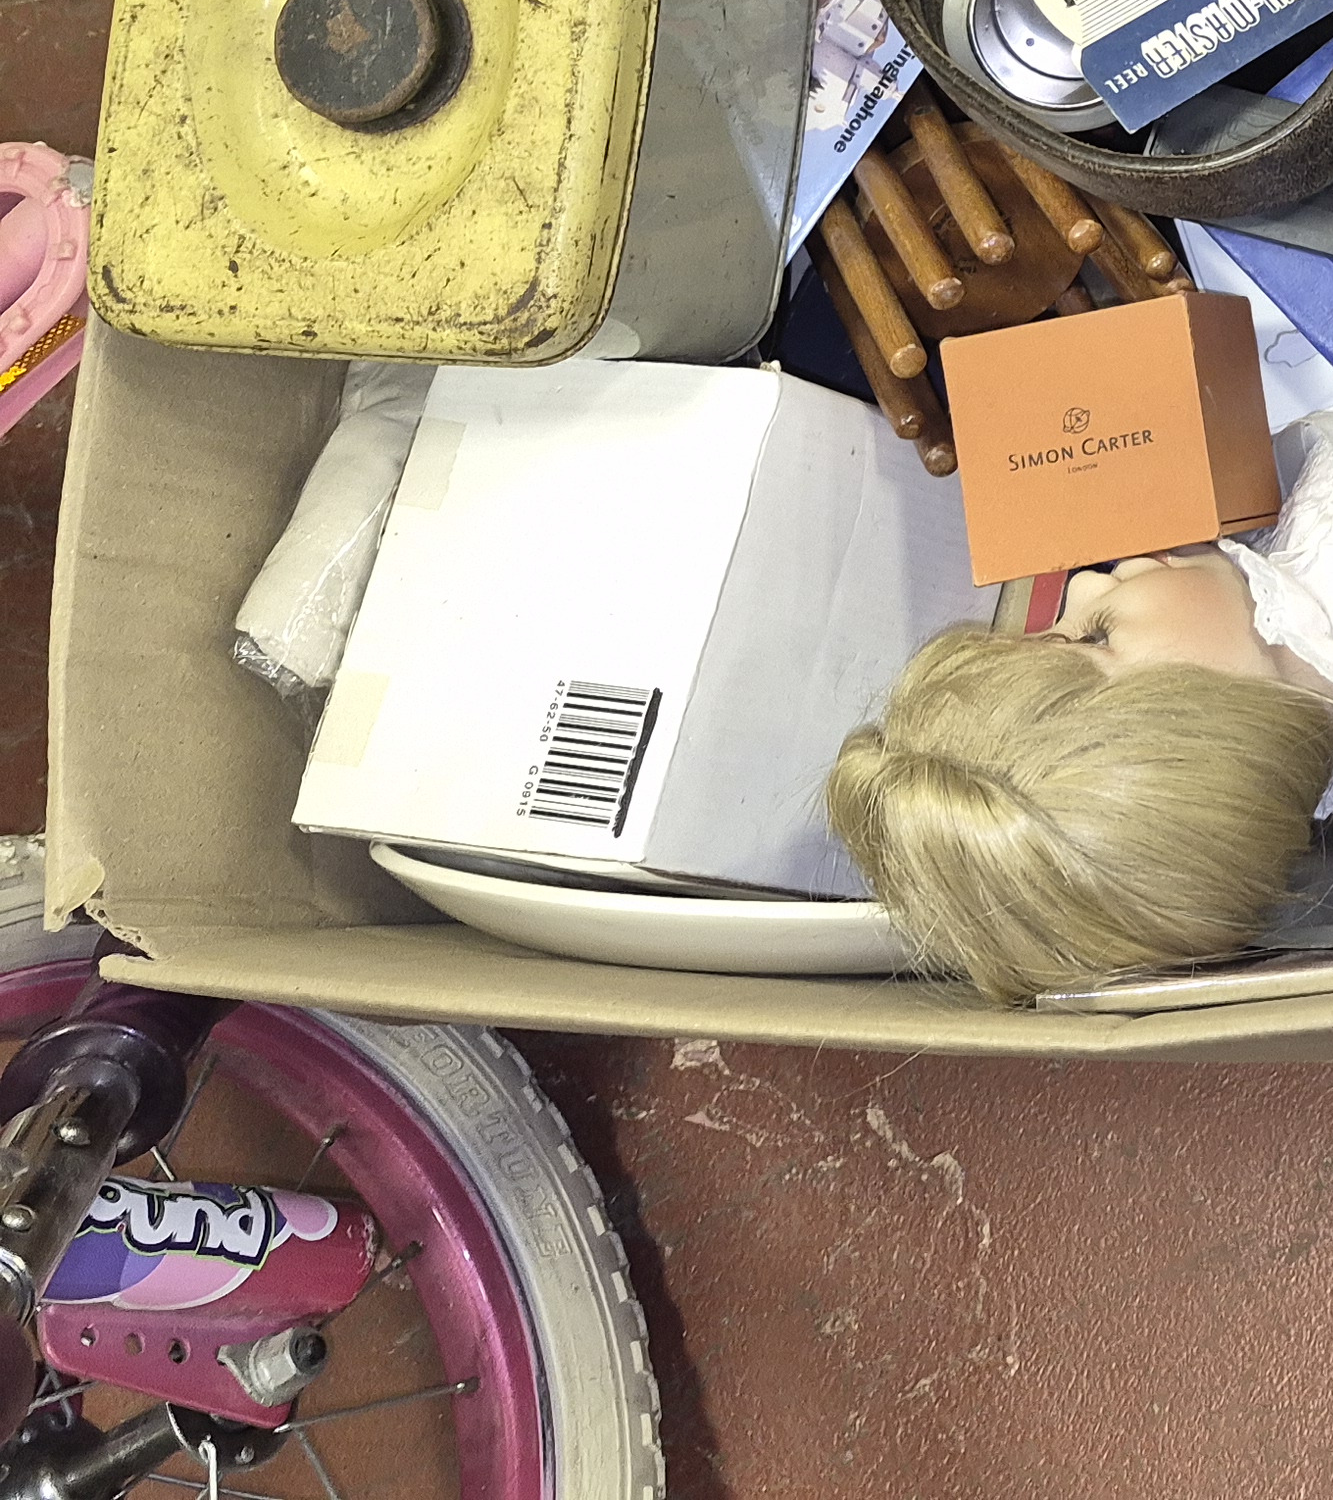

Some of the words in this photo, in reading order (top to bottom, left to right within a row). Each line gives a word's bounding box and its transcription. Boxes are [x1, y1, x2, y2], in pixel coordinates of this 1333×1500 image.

[832, 42, 926, 155] inguaphone
[1104, 62, 1149, 95] REEL
[1007, 445, 1075, 472] SIMON
[1080, 427, 1155, 457] CARTER
[537, 677, 566, 745] 47-62-50
[515, 779, 535, 819] 0915
